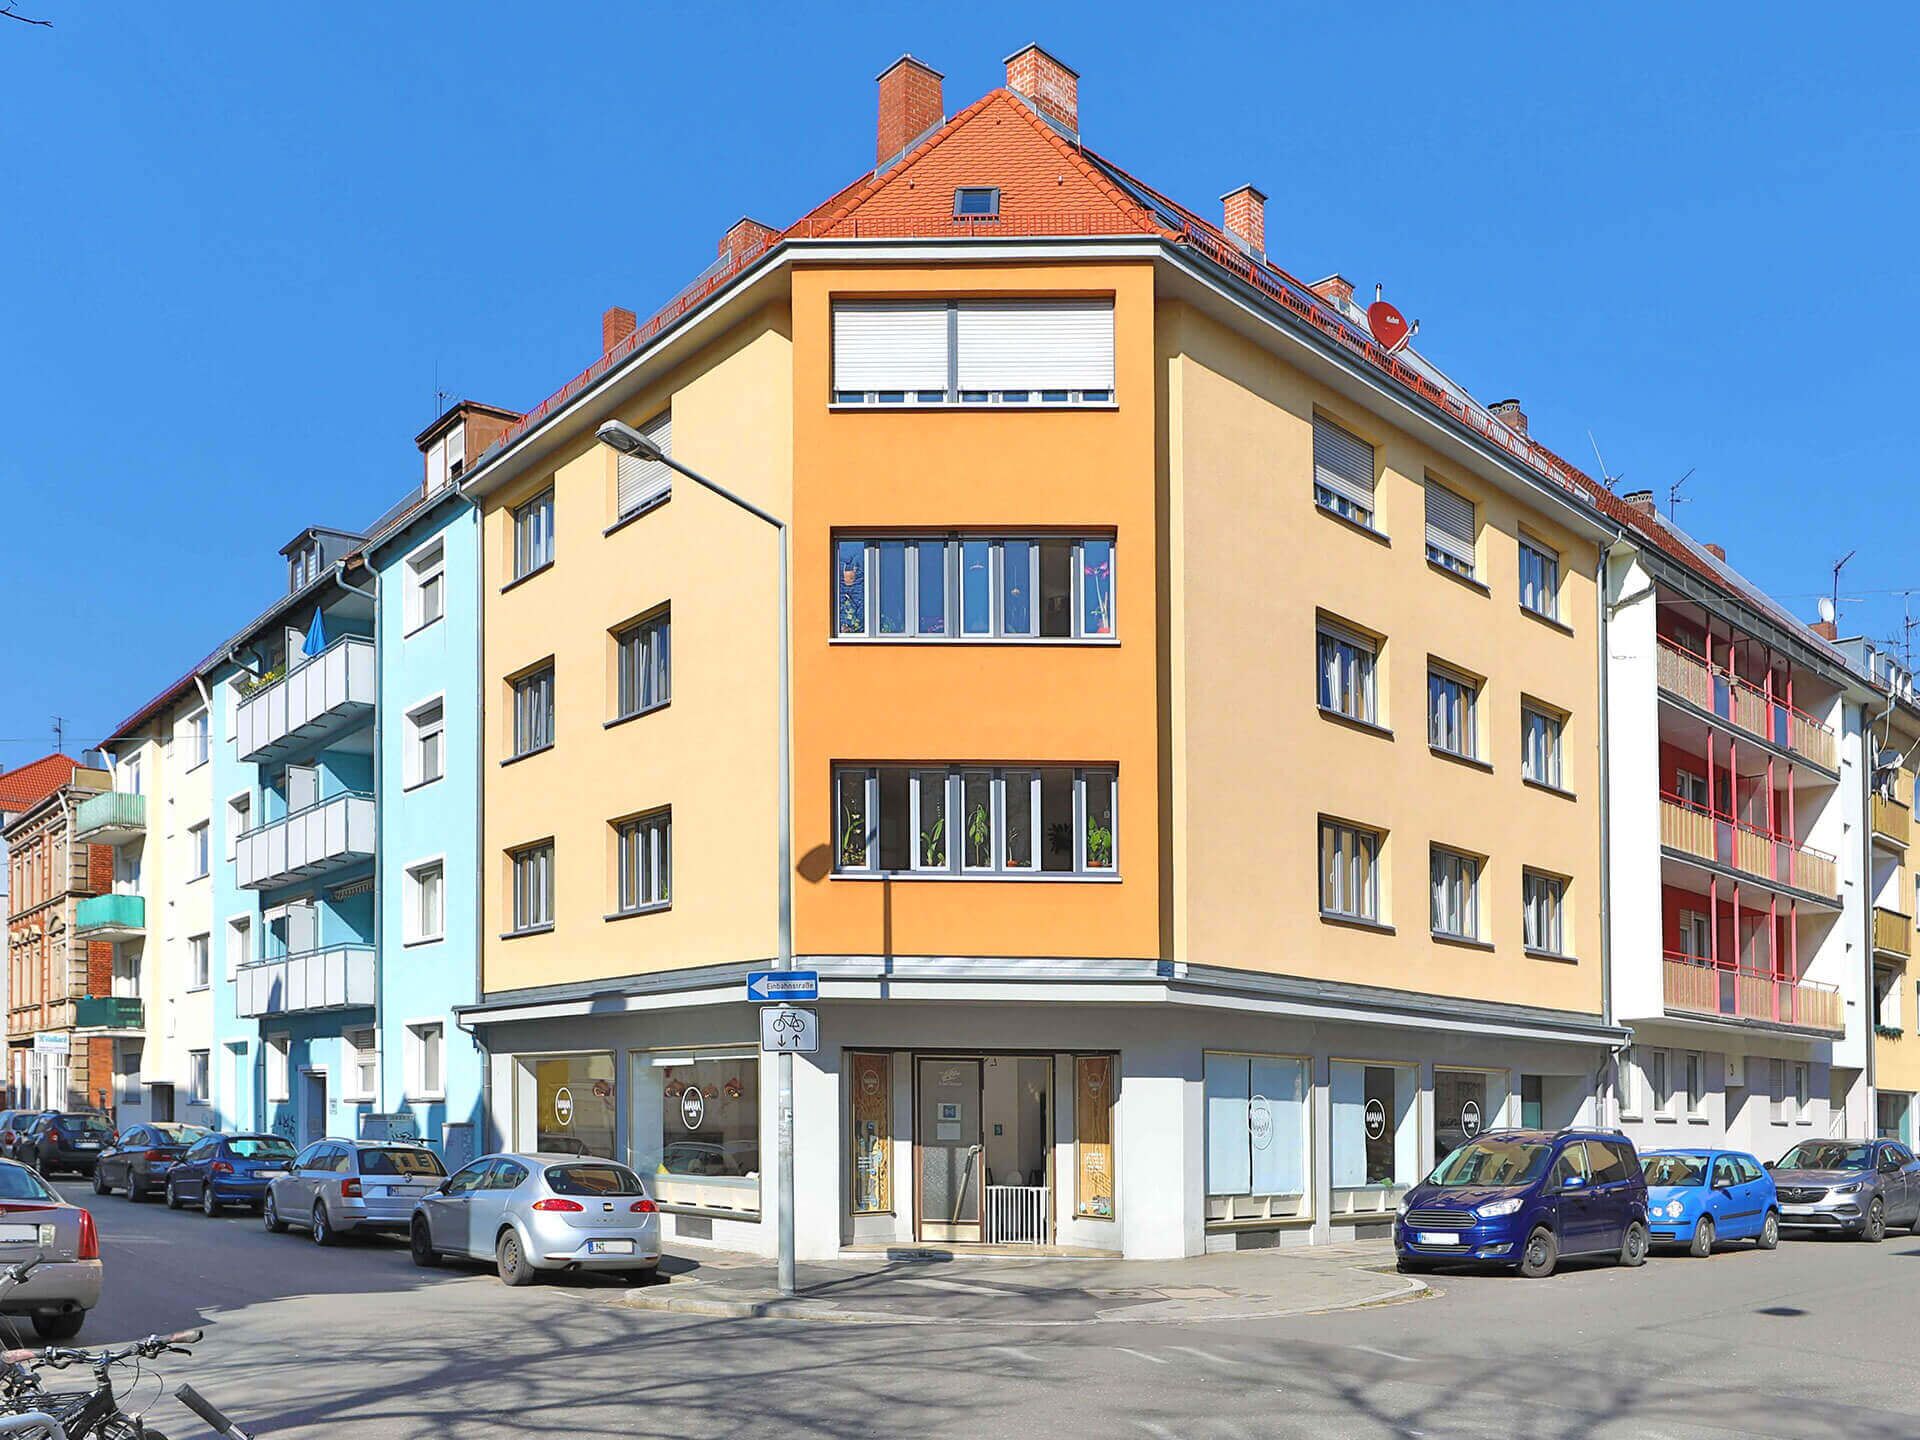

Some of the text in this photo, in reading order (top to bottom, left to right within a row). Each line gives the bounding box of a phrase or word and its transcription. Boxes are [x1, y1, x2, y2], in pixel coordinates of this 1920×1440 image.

[767, 982, 814, 990] Einbahnstraße
[684, 1100, 702, 1111] MAMA
[1366, 1111, 1384, 1122] MAMA
